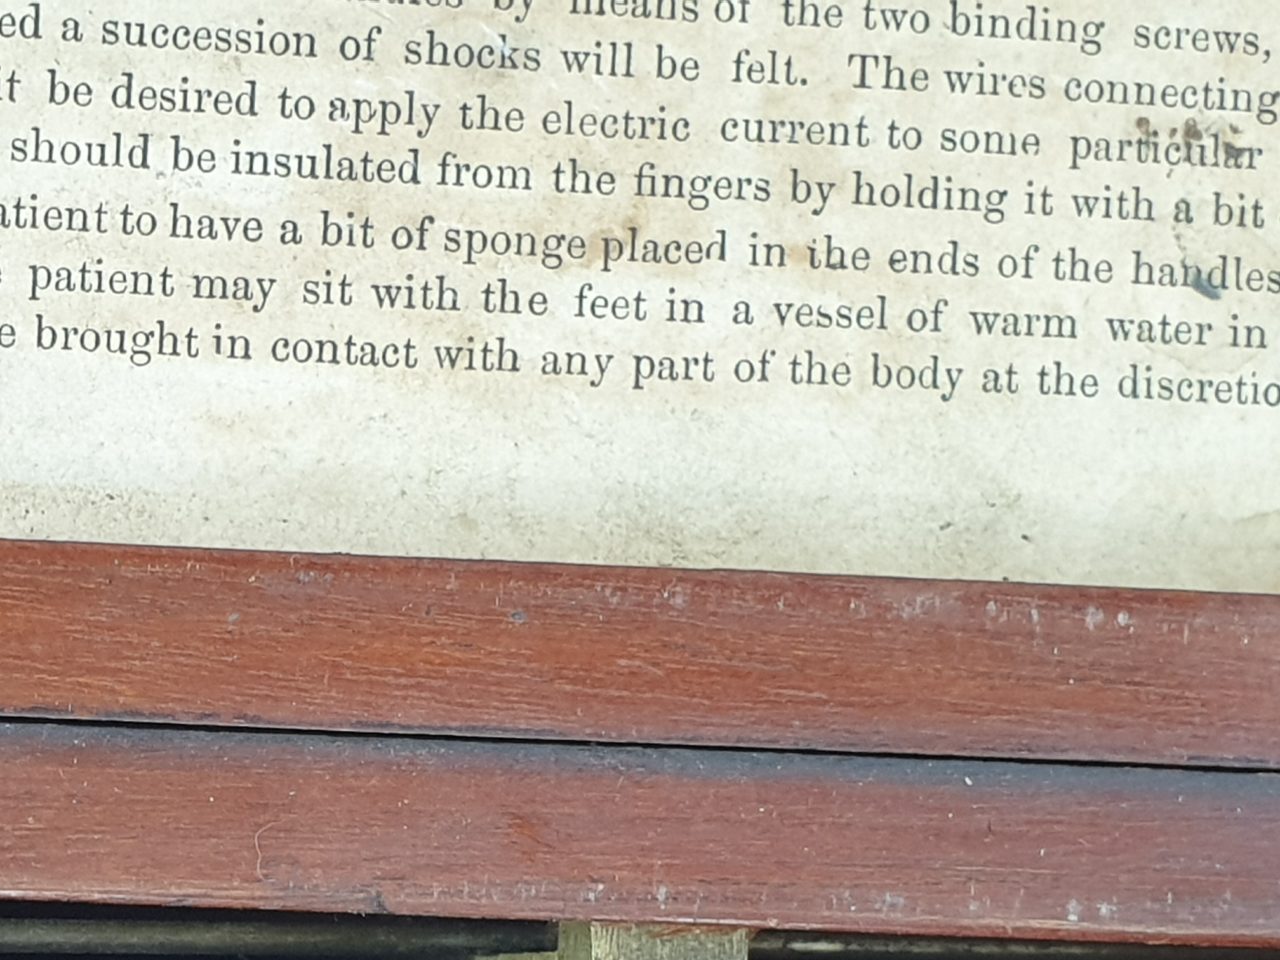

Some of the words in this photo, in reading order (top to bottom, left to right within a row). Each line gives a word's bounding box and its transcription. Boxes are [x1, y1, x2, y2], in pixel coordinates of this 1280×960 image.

[61, 17, 83, 42] a
[102, 18, 317, 58] succession
[339, 25, 382, 62] of
[404, 29, 541, 72] shocks
[560, 40, 635, 78] will
[656, 44, 699, 81] be
[731, 48, 807, 86] felt.
[848, 53, 929, 92] The
[943, 59, 1046, 99] wires
[1064, 77, 1280, 125] connecting
[494, 0, 532, 23] y
[569, 0, 699, 23] means
[714, 0, 750, 23] of
[780, 0, 843, 28] the
[863, 0, 930, 34] two
[950, 0, 1105, 56] binding
[1134, 25, 1271, 64] screws,
[47, 68, 93, 107] be
[111, 72, 259, 117] desired
[277, 86, 316, 120] to
[328, 90, 441, 139] apply
[459, 94, 525, 132] the
[542, 100, 690, 142] electric
[720, 115, 870, 147] current
[888, 120, 922, 150] to
[941, 128, 1040, 156] some
[1069, 130, 1263, 170] particular
[11, 126, 150, 170] should
[171, 135, 216, 173] be
[230, 139, 421, 185] insulated
[436, 151, 532, 190] from
[552, 158, 616, 195] the
[634, 162, 771, 211] fingers
[790, 168, 836, 216] by
[851, 170, 1008, 224] holding
[1024, 180, 1053, 216] it
[1071, 185, 1156, 222] with
[1173, 198, 1194, 225] a
[1213, 191, 1265, 229] bit
[120, 204, 157, 236] to
[169, 202, 263, 242] have
[280, 220, 302, 246] a
[320, 210, 374, 249] bit
[391, 215, 435, 251] of
[444, 228, 586, 270] sponge
[600, 226, 726, 272] placed
[749, 232, 786, 267] in
[806, 234, 871, 271] the
[888, 240, 979, 277] ends
[998, 244, 1040, 279] of
[1052, 247, 1113, 283] the
[1131, 252, 1280, 294] handles
[28, 258, 174, 301] patient
[191, 275, 277, 313] may
[303, 269, 353, 306] sit
[370, 274, 461, 311] with
[481, 278, 548, 316] the
[574, 283, 647, 321] feet
[665, 287, 705, 324] in
[732, 301, 754, 325] a
[773, 295, 888, 330] vessel
[907, 299, 948, 332] of
[969, 311, 1077, 339] warm
[1105, 314, 1213, 345] water
[1228, 314, 1267, 349] in
[36, 314, 199, 367] brought
[212, 323, 252, 360] in
[271, 335, 418, 369] contact
[434, 336, 520, 372] with
[541, 351, 614, 388] any
[632, 352, 715, 390] part
[734, 349, 776, 383] of
[789, 350, 851, 386] the
[871, 352, 964, 402] body
[982, 363, 1018, 394] at
[1037, 361, 1098, 398] the
